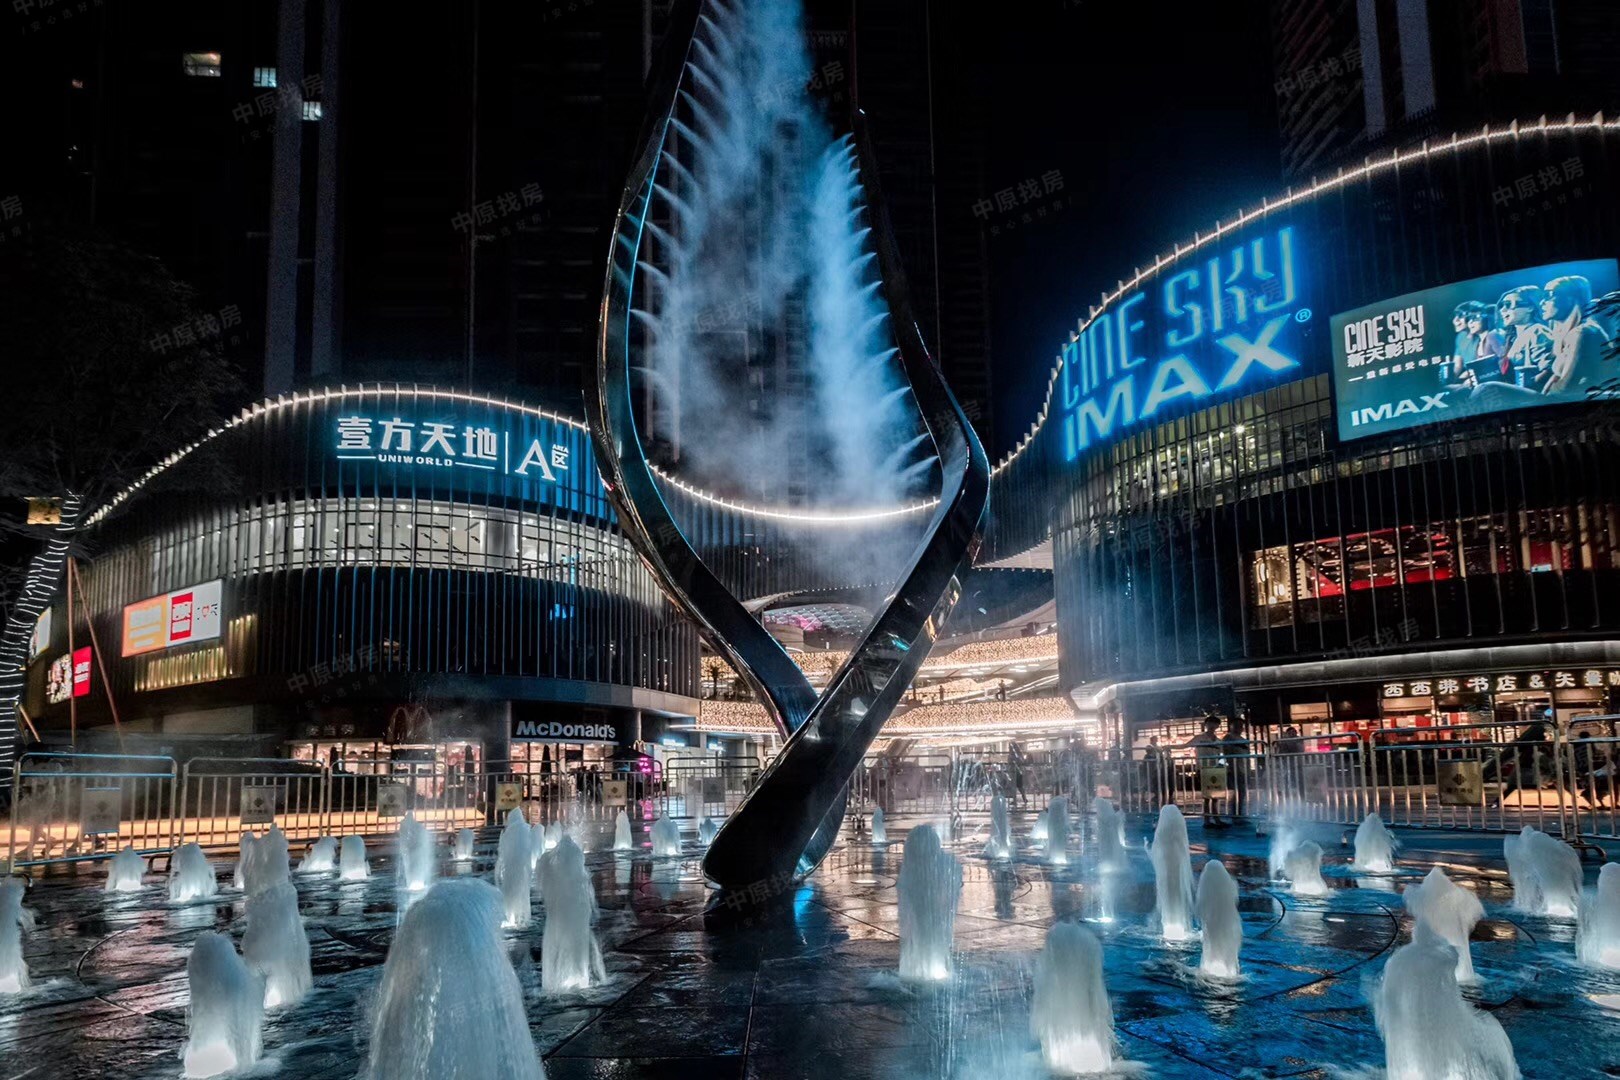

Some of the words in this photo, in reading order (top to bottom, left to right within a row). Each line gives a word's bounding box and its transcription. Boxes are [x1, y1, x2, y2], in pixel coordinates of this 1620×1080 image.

[1063, 291, 1147, 410] CINE
[1163, 226, 1297, 347] SKY
[1344, 315, 1385, 354] CINE
[1386, 305, 1425, 343] SKY
[1064, 313, 1301, 461] IMAX
[1351, 391, 1449, 426] IMAX
[336, 415, 498, 461] 壹方天地
[378, 453, 454, 467] UNIWORLD
[514, 438, 557, 482] A
[551, 450, 569, 470] 区
[516, 720, 616, 739] McDonald's
